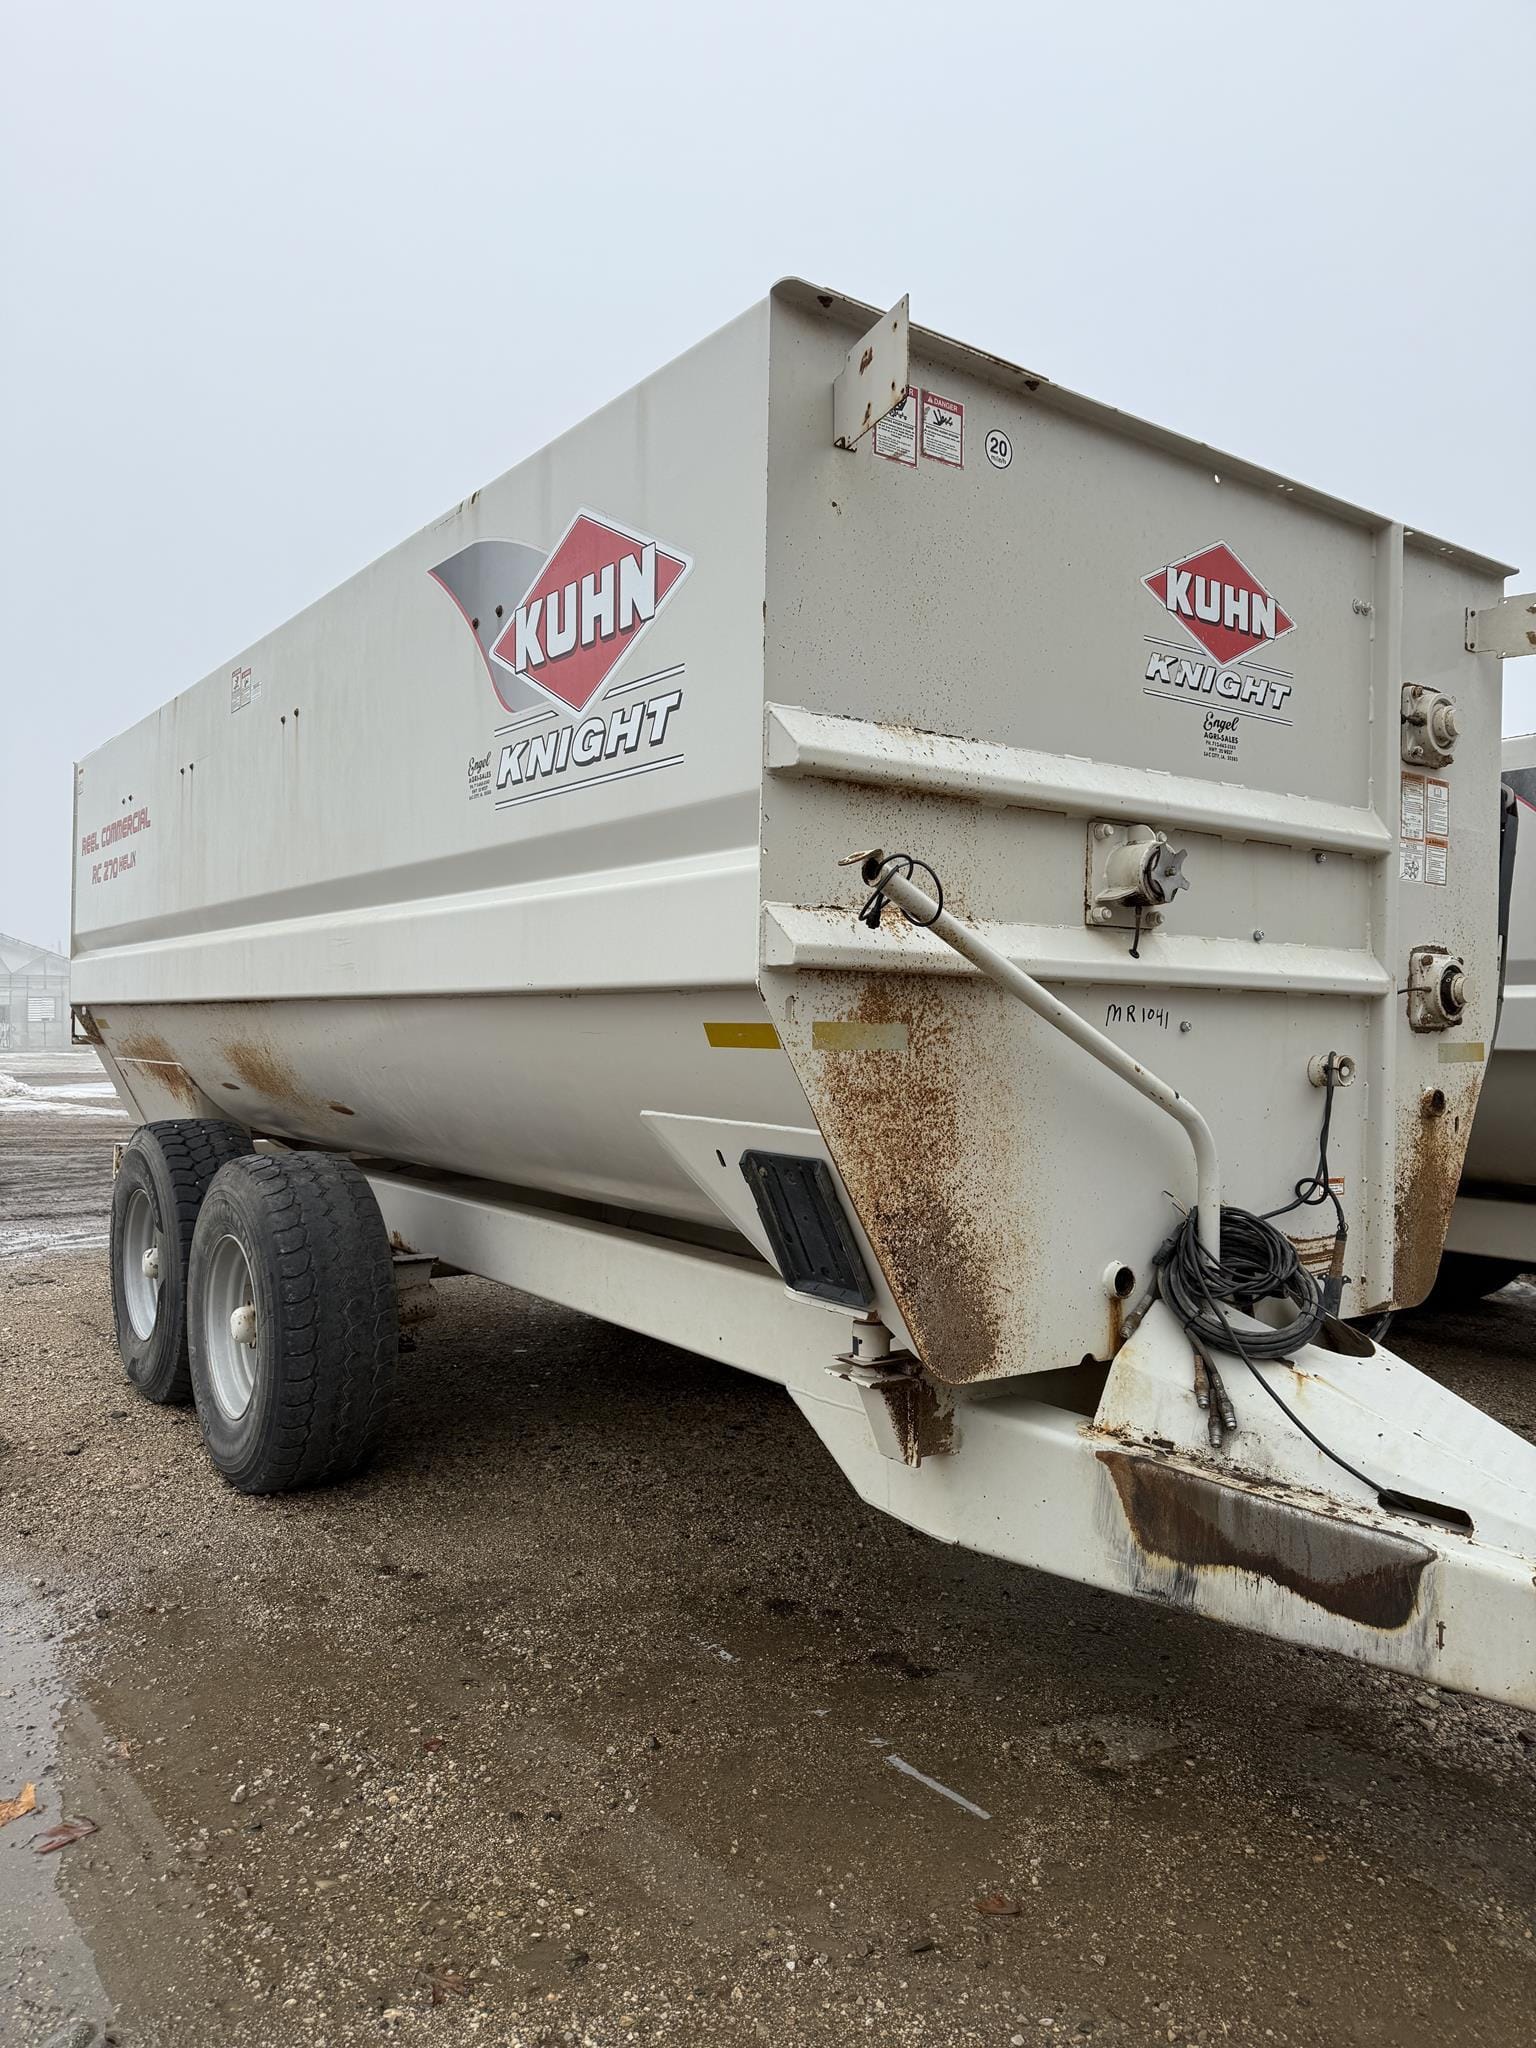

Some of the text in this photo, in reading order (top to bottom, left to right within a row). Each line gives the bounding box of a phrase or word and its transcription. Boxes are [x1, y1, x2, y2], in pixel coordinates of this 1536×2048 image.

[933, 397, 958, 413] DANGER
[990, 436, 1007, 457] 20
[514, 542, 657, 675] KUHN
[1166, 565, 1277, 640] KUHN
[1145, 652, 1291, 710] KNIGHT
[1203, 711, 1240, 733] Engel
[496, 689, 682, 790] KNIGHT
[1204, 732, 1239, 744] AGRI-SALES
[468, 751, 492, 777] Engel
[81, 806, 151, 856] REEL COMMERCIAL
[92, 862, 102, 885] RC
[103, 857, 118, 881] 270
